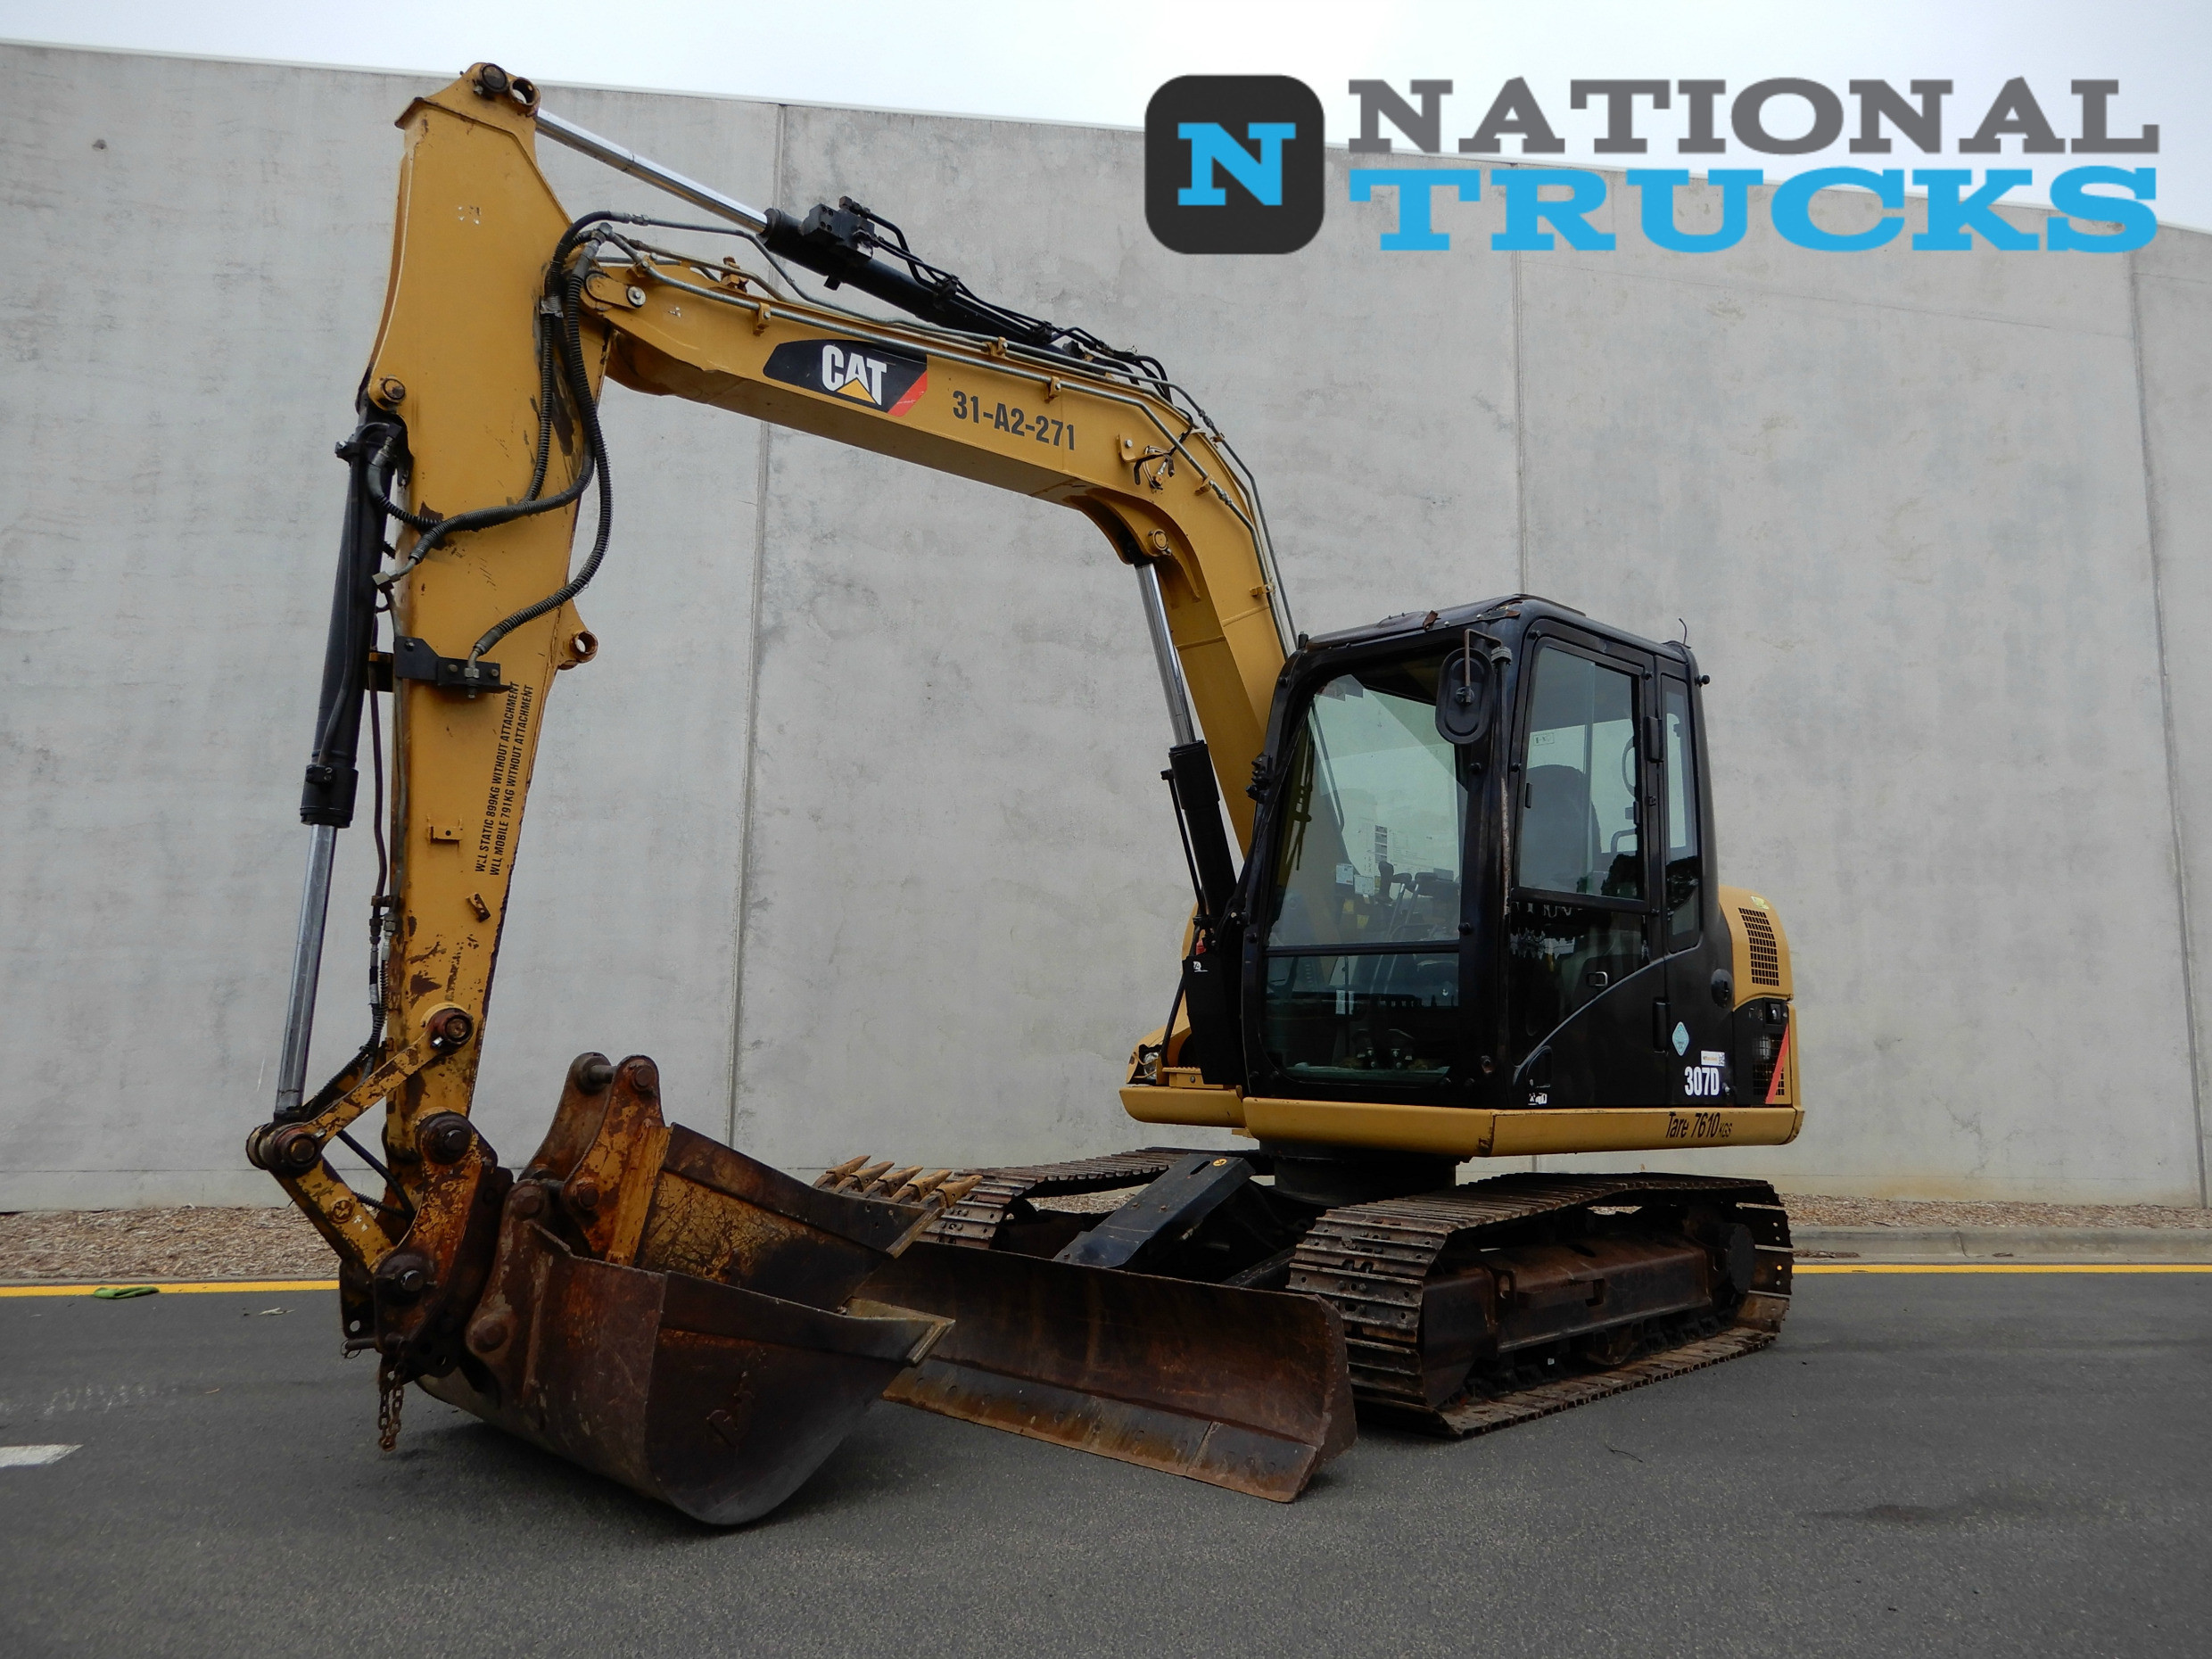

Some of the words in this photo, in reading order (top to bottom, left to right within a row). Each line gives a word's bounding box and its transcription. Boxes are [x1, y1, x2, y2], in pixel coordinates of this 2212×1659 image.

[821, 344, 887, 406] CAT
[953, 390, 1075, 450] 31-A2-271
[500, 681, 519, 742] ATTACHMENT
[515, 684, 533, 745] ATTACHMENT
[491, 743, 508, 784] WITHOUT
[507, 746, 523, 787] WITHOUT
[485, 786, 500, 817] 899KG
[500, 788, 515, 818] 791KG
[479, 819, 494, 852] STATIC
[494, 821, 508, 855] MOBILE
[489, 857, 502, 875] WLL
[1684, 1066, 1720, 1096] 307D
[1665, 1111, 1689, 1138] Tare
